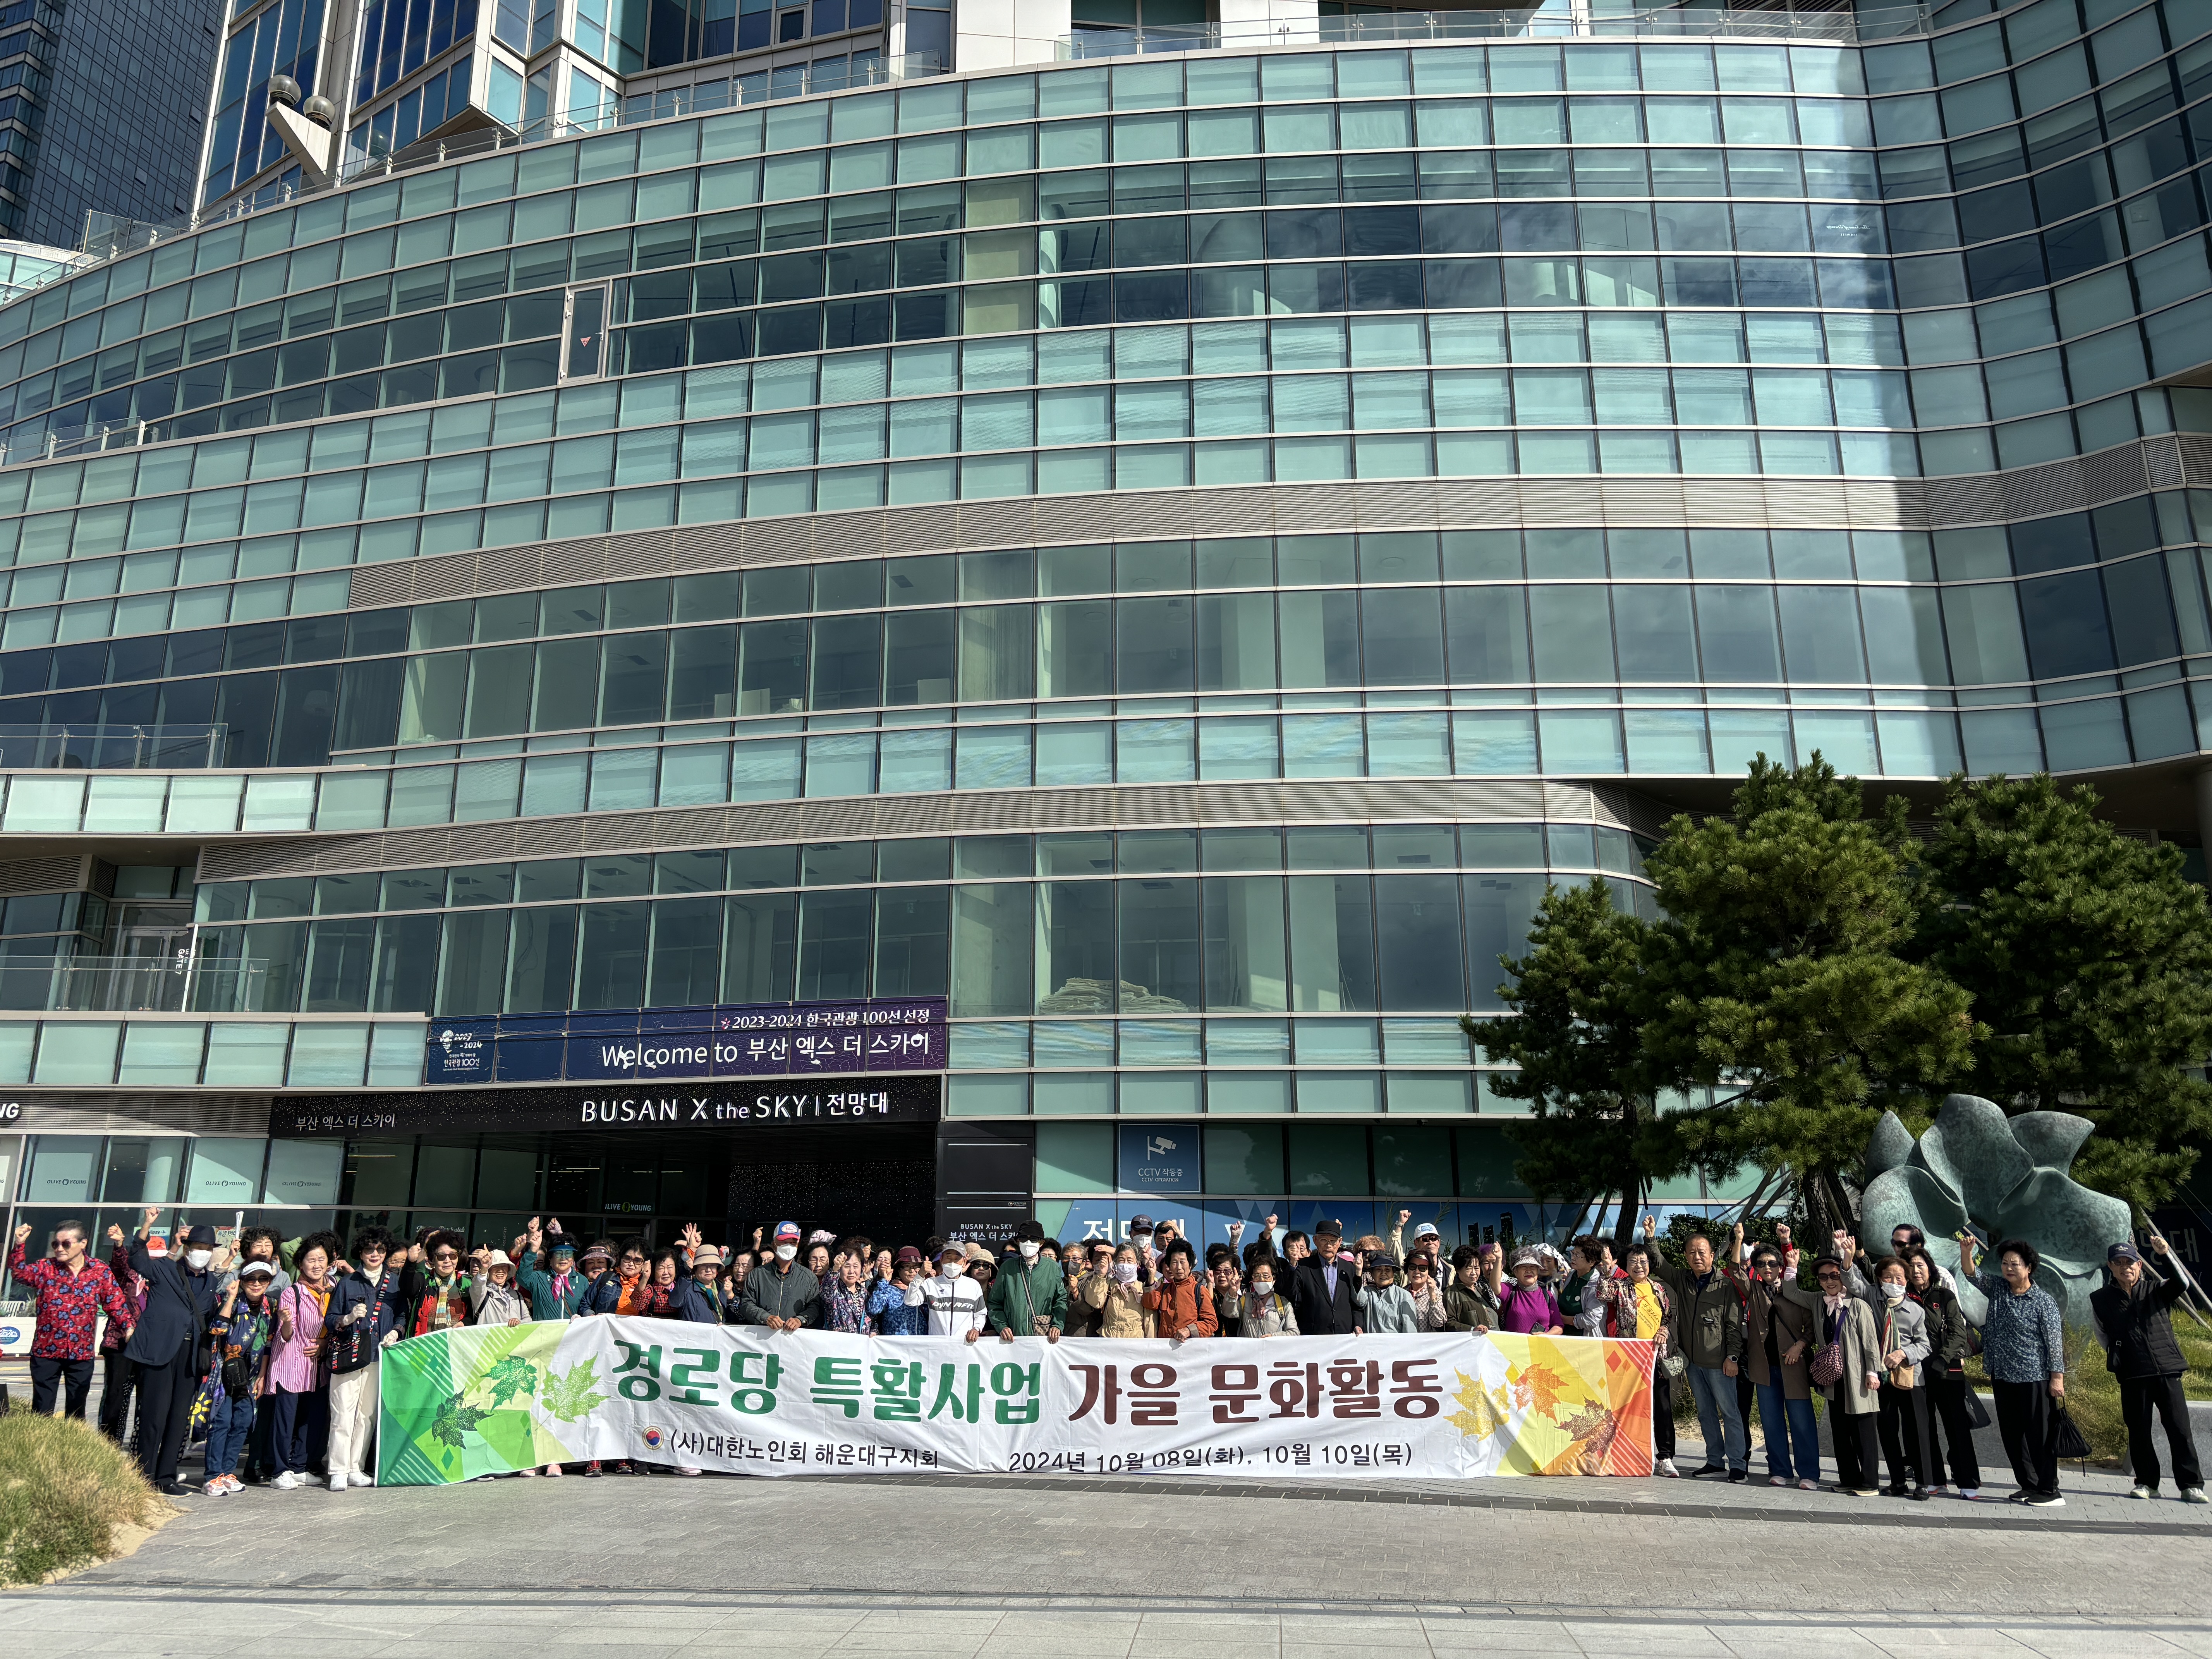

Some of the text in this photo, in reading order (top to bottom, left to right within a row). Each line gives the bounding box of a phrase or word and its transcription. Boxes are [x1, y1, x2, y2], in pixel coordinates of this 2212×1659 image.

[175, 949, 185, 969] GATE
[732, 1009, 929, 1029] 2023-2024 한국관광 100선 선정
[602, 1032, 929, 1067] Welcome to 부산 엑스 더 스카이
[582, 1091, 888, 1122] BUSAN X the SKY 전망대
[295, 1113, 395, 1131] 부산 엑스 더 스카이
[1138, 1168, 1183, 1176] CCTV 작동중
[949, 1231, 1018, 1242] 부산 엑스 더 스카
[611, 1340, 1443, 1426] 경로당 특활사업 가을 문화활동
[671, 1429, 1412, 1473] (사)대한노인회 해운대구지회 2024년 10월 08일(화), 10월 10일(목)
